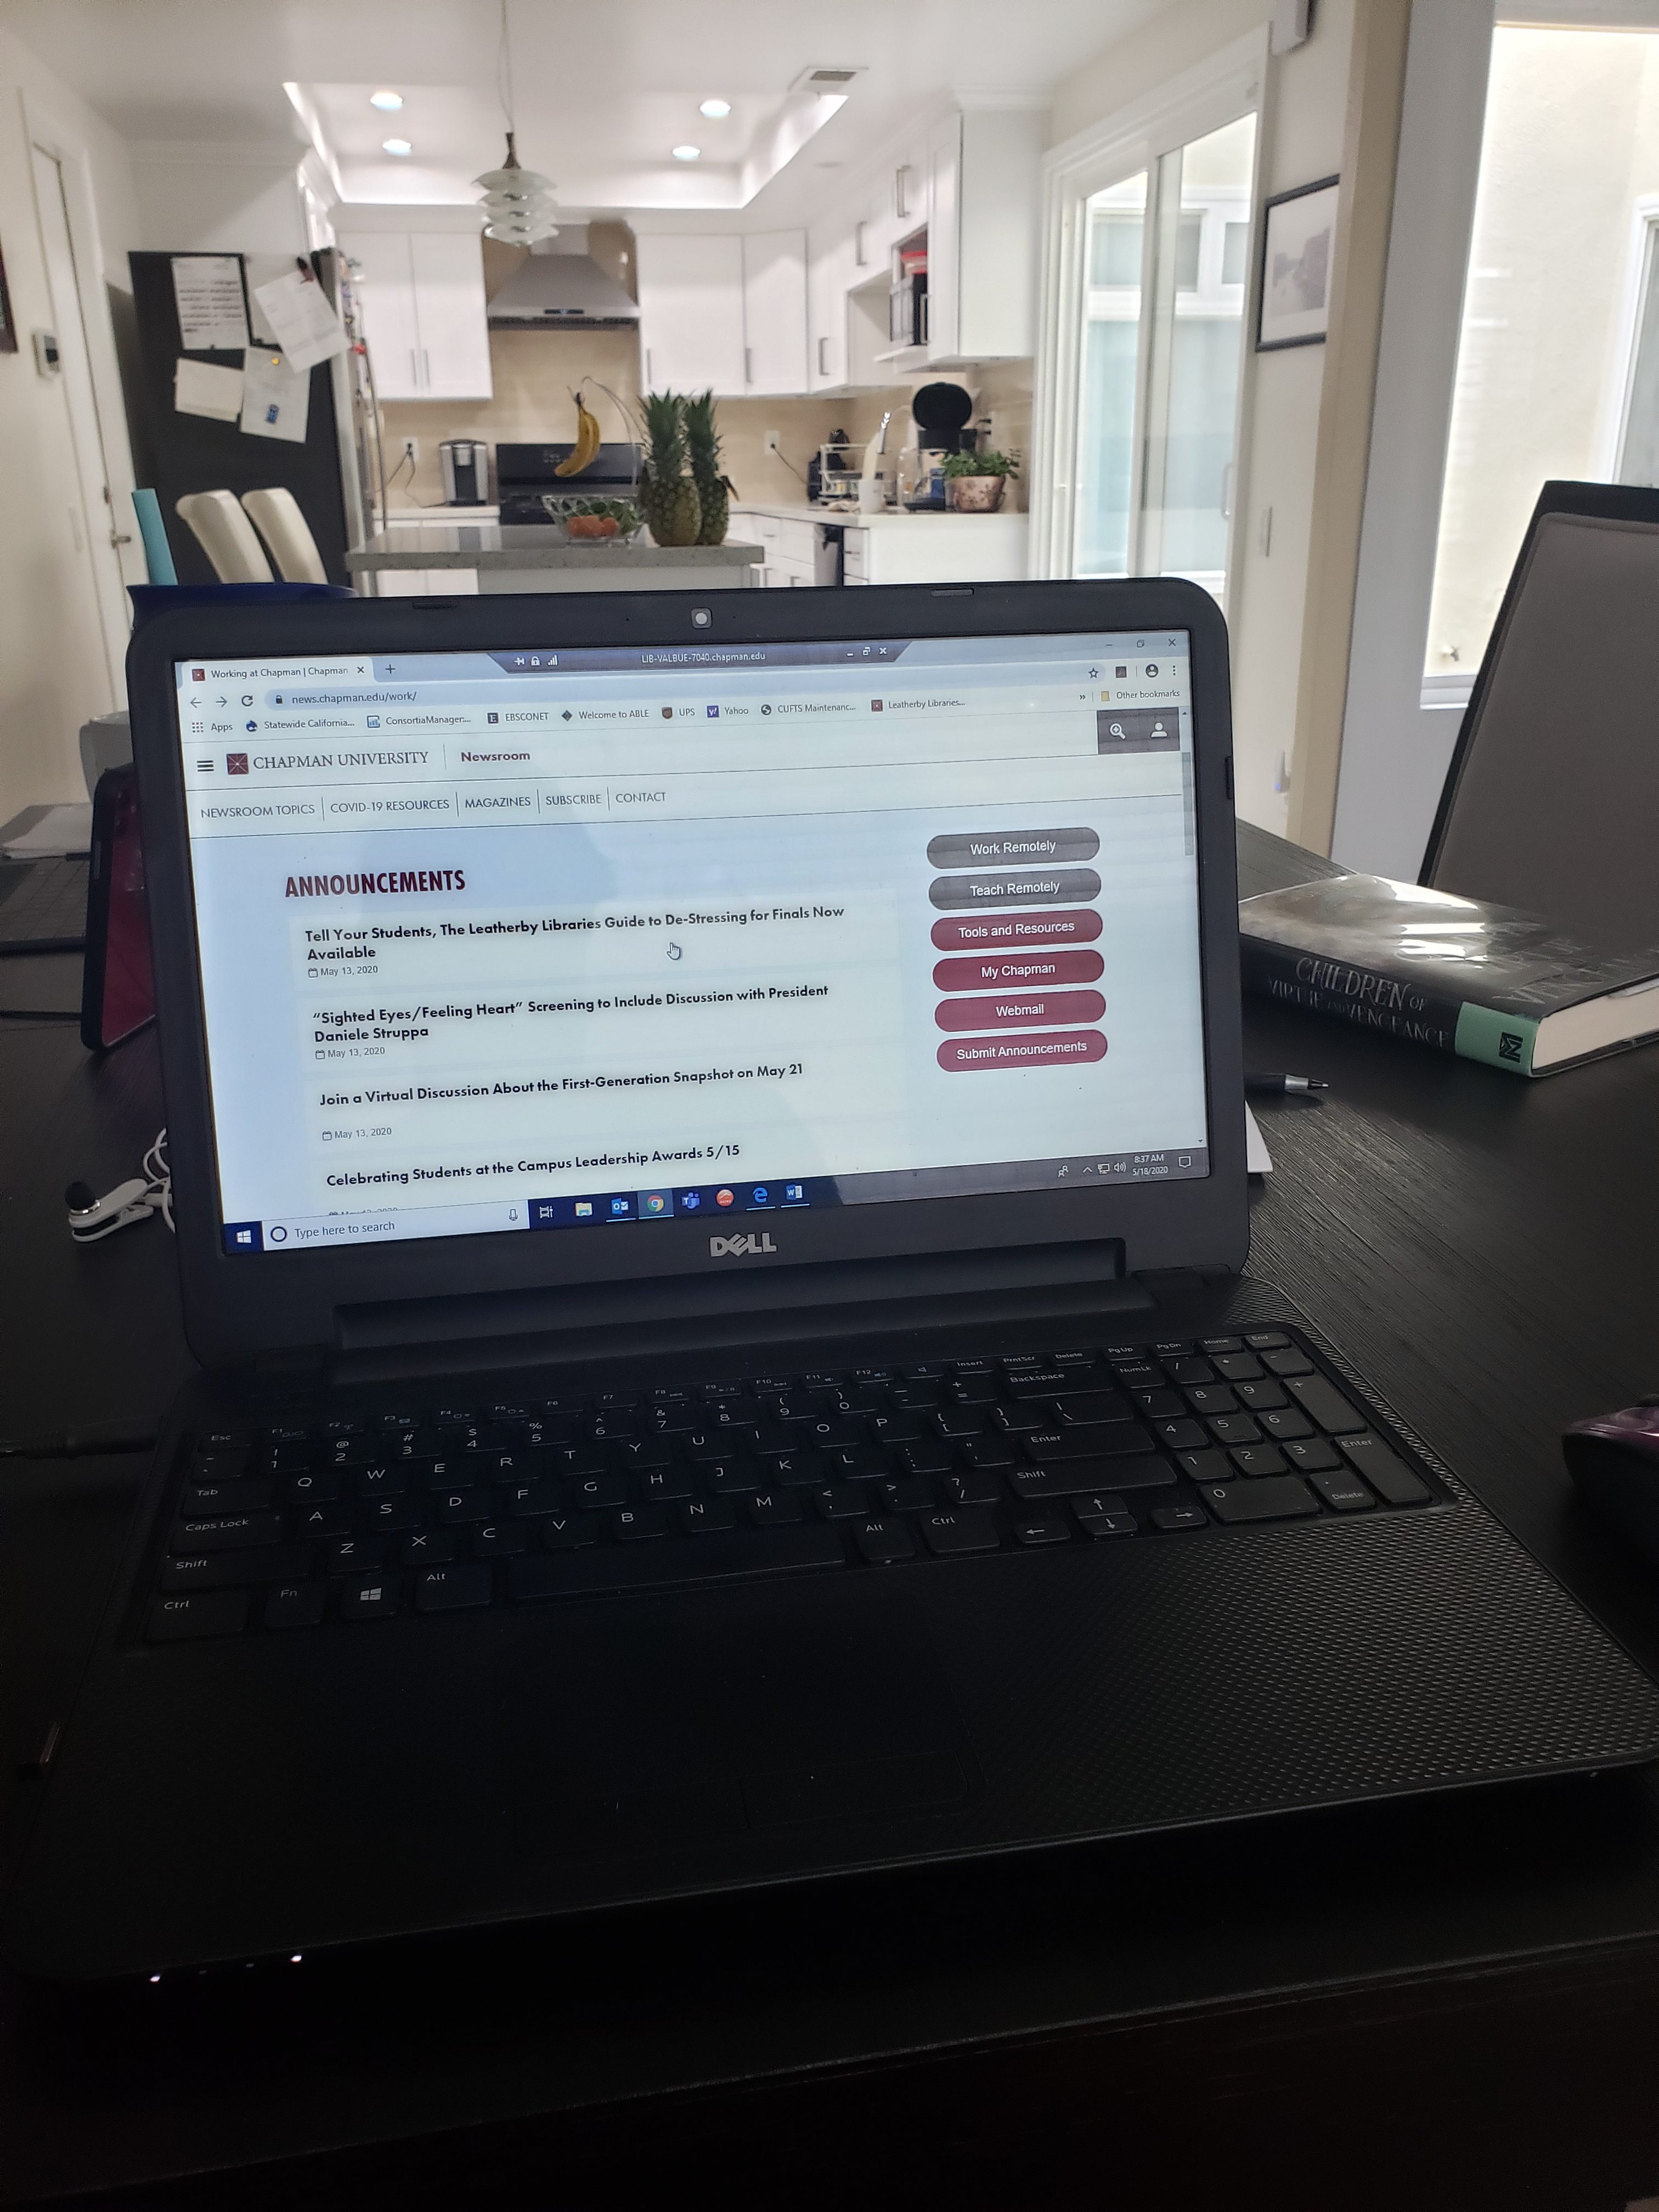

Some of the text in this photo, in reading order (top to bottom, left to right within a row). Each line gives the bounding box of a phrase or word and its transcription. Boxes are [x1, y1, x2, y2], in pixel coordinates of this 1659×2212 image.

[642, 652, 765, 663] LIB-VALBUE-7040.chapman.edu
[211, 669, 247, 680] Working
[261, 669, 301, 678] Chapman
[292, 691, 416, 704] news.chapman.edu/work/
[1116, 690, 1180, 699] Other bookmarks
[889, 699, 926, 709] Leatherby
[579, 710, 616, 720] Welcome
[629, 710, 648, 718] ABLE
[679, 708, 695, 716] UPS
[724, 706, 748, 715] Yahoo
[505, 713, 549, 721] EBSCONET
[211, 723, 233, 733] Apps
[264, 720, 306, 729] Statewide
[253, 751, 428, 770] CHAPMAN UNIVERSITY
[461, 751, 530, 763] Newsroom
[465, 796, 531, 809] MAGAZINES
[545, 793, 602, 805] SUBSCRIBE
[616, 792, 666, 803] CONTACT
[330, 799, 449, 813] COVID-19 RESOURCES
[201, 804, 315, 819] NEWSROOM TOPICS
[970, 839, 1056, 855] Work Remotely
[285, 870, 465, 898] ANNOUNCEMENTS
[970, 881, 1060, 896] Teach Remotely
[305, 907, 844, 943] Tell Your Students, The Leatherby Libraries Guide to De-Stressing for Finals Now
[958, 922, 1075, 938] Tools and Resources
[307, 946, 376, 961] Available
[320, 966, 378, 977] May 13, 2020
[981, 963, 1055, 979] My Chapman
[1296, 957, 1412, 1011] CHILDREN
[380, 1006, 473, 1024] Eyes/Feeling
[528, 998, 594, 1014] Screening
[597, 998, 611, 1008] to
[614, 995, 662, 1008] Include
[666, 991, 733, 1005] Discussion
[736, 988, 765, 1001] with
[769, 985, 828, 999] President
[996, 1003, 1045, 1017] Webmail
[315, 1027, 428, 1043] Daniele Struppa
[328, 1047, 385, 1059] May 13, 2020
[957, 1041, 1087, 1060] Submit Announcements
[320, 1064, 803, 1106] Join a Virtual Discussion About the First-Generation Snapshot on May 21
[335, 1128, 392, 1140] May 13, 2020
[1135, 1154, 1164, 1164] 8:37 AM
[326, 1144, 740, 1187] Celebrating Students at the Campus Leadership Awards 5/15
[1132, 1166, 1168, 1176] 5/18/2020
[295, 1221, 395, 1239] Type here to search
[710, 1233, 777, 1256] DELL
[1204, 1338, 1229, 1346] Home
[1009, 1372, 1065, 1384] Backspace
[876, 1418, 888, 1427] P
[692, 1436, 705, 1445] U
[1030, 1434, 1062, 1443] Enter
[1342, 1438, 1373, 1448] Enter
[629, 1443, 641, 1452] Y
[564, 1449, 575, 1459] T
[500, 1457, 513, 1466] R
[434, 1464, 445, 1473] E
[715, 1467, 724, 1476] J
[366, 1469, 386, 1480] W
[650, 1475, 663, 1484] H
[1017, 1470, 1046, 1480] Shift
[297, 1477, 313, 1487] Q
[584, 1482, 597, 1491] G
[197, 1488, 218, 1497] Tab
[517, 1489, 528, 1499] F
[1331, 1491, 1364, 1501] Delete
[449, 1497, 462, 1506] D
[380, 1504, 392, 1514] S
[309, 1511, 323, 1521] A
[932, 1516, 955, 1525] Ctrl
[186, 1519, 249, 1532] Caps Lock
[866, 1524, 883, 1533] Alt
[176, 1559, 207, 1570] Shift
[426, 1573, 447, 1581] Alt
[280, 1590, 297, 1598] Fn
[164, 1600, 189, 1610] Ctrl
